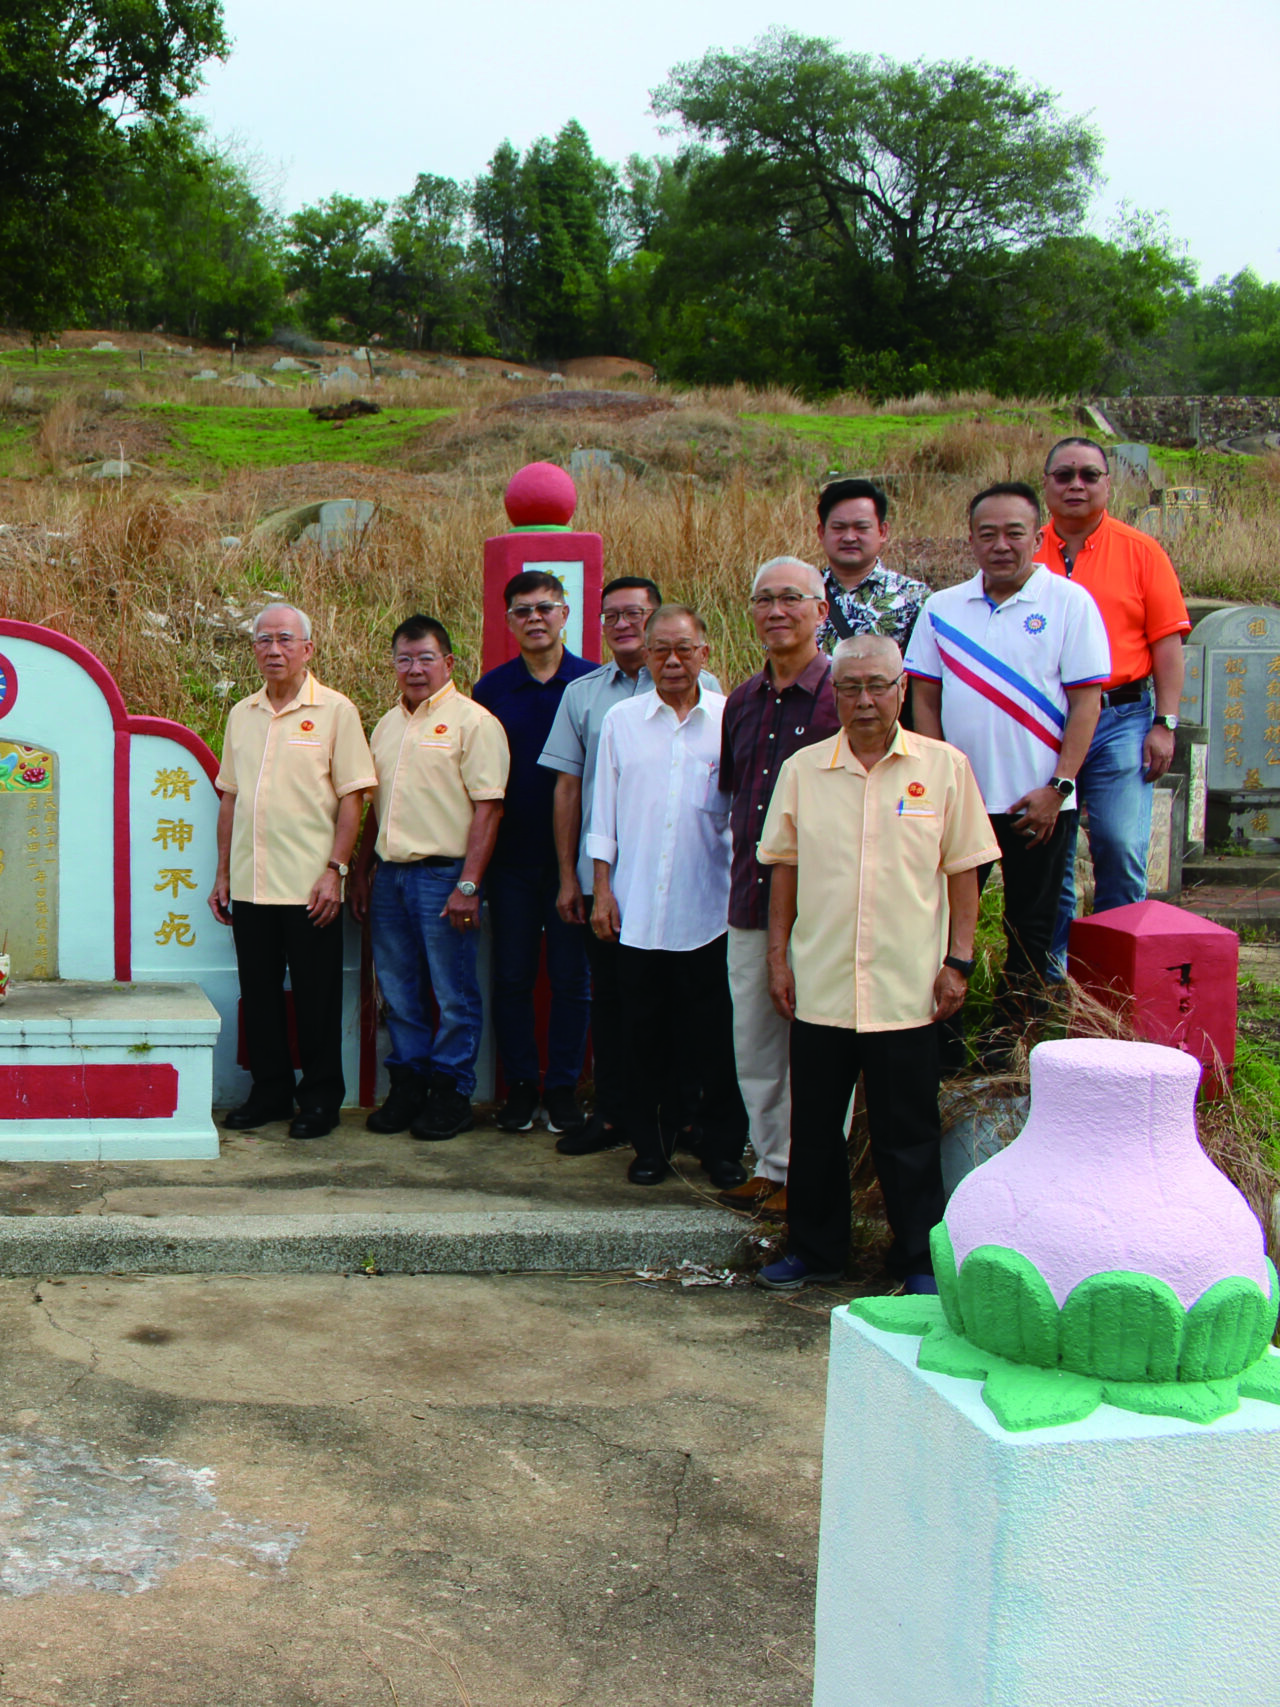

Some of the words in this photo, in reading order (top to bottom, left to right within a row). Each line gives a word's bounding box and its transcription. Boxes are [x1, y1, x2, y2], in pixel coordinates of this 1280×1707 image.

[1247, 617, 1268, 637] 祖
[1243, 768, 1263, 790] 墓
[151, 766, 198, 947] 精神不死
